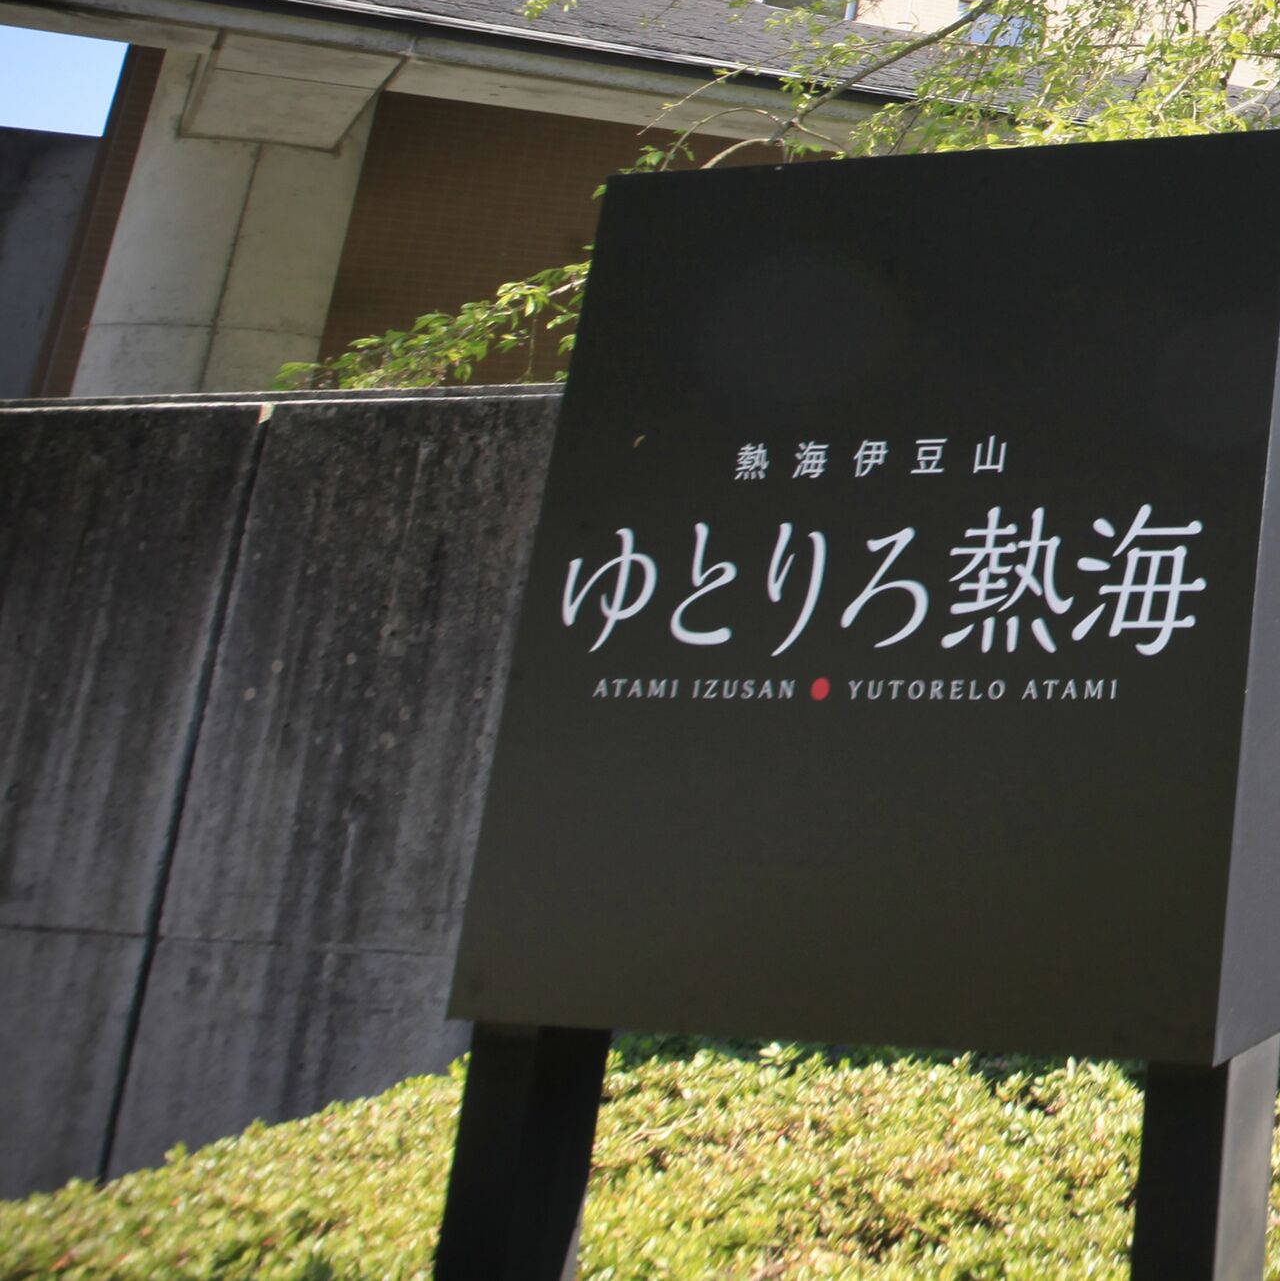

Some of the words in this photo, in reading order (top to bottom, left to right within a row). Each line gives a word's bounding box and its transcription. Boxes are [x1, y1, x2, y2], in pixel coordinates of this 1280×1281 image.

[734, 434, 1008, 481] 熱海伊豆山
[562, 504, 1207, 656] ゆとりろ熱海
[592, 678, 680, 700] ATAMI
[692, 678, 796, 701] IZUSAN
[847, 679, 1006, 701] YUTORELO
[1021, 678, 1119, 701] ATAMI
